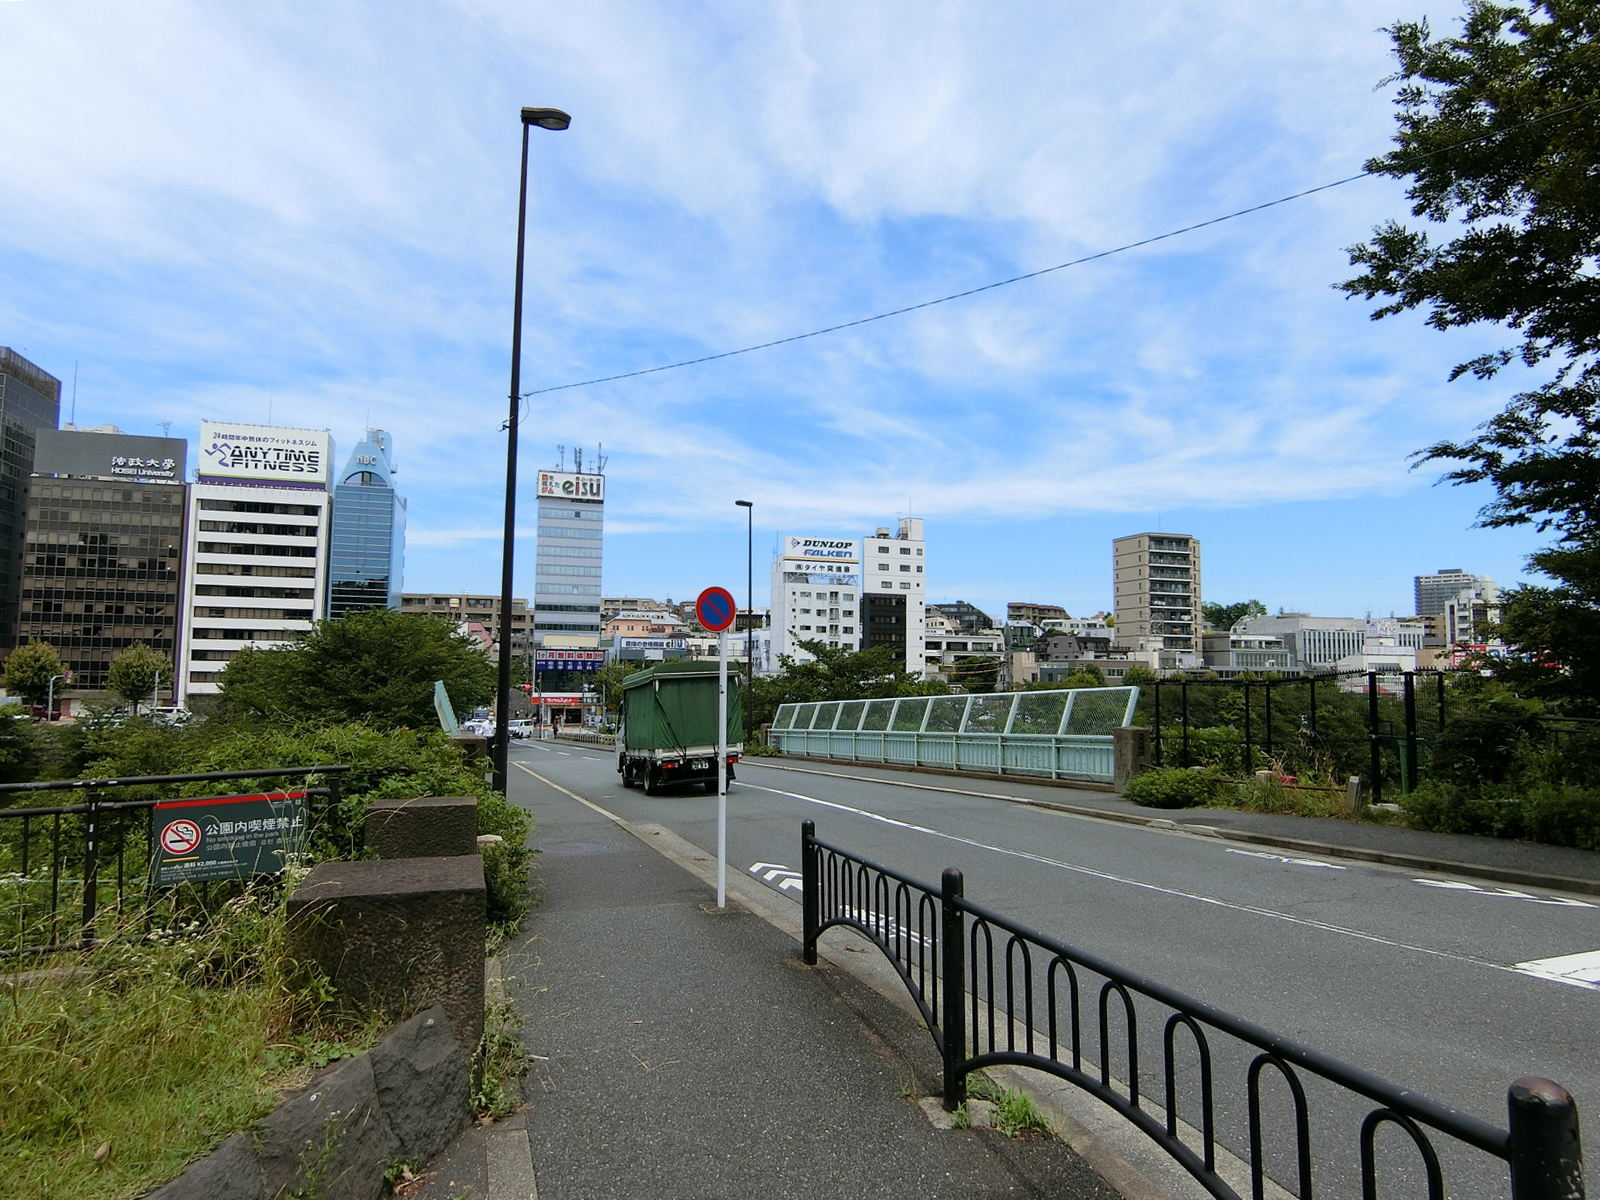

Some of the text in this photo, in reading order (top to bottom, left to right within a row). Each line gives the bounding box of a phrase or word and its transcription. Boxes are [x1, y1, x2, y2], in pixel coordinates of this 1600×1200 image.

[230, 445, 320, 463] ANYTIME
[231, 458, 319, 473] FITNESS
[356, 455, 377, 466] NBC
[111, 467, 137, 475] HOSEI
[562, 476, 601, 497] eisu
[802, 539, 853, 549] DUNLOP
[803, 549, 853, 558] FALKEN
[205, 816, 304, 836] 公園内喫煙禁止
[217, 833, 245, 842] smoking
[265, 830, 280, 838] park
